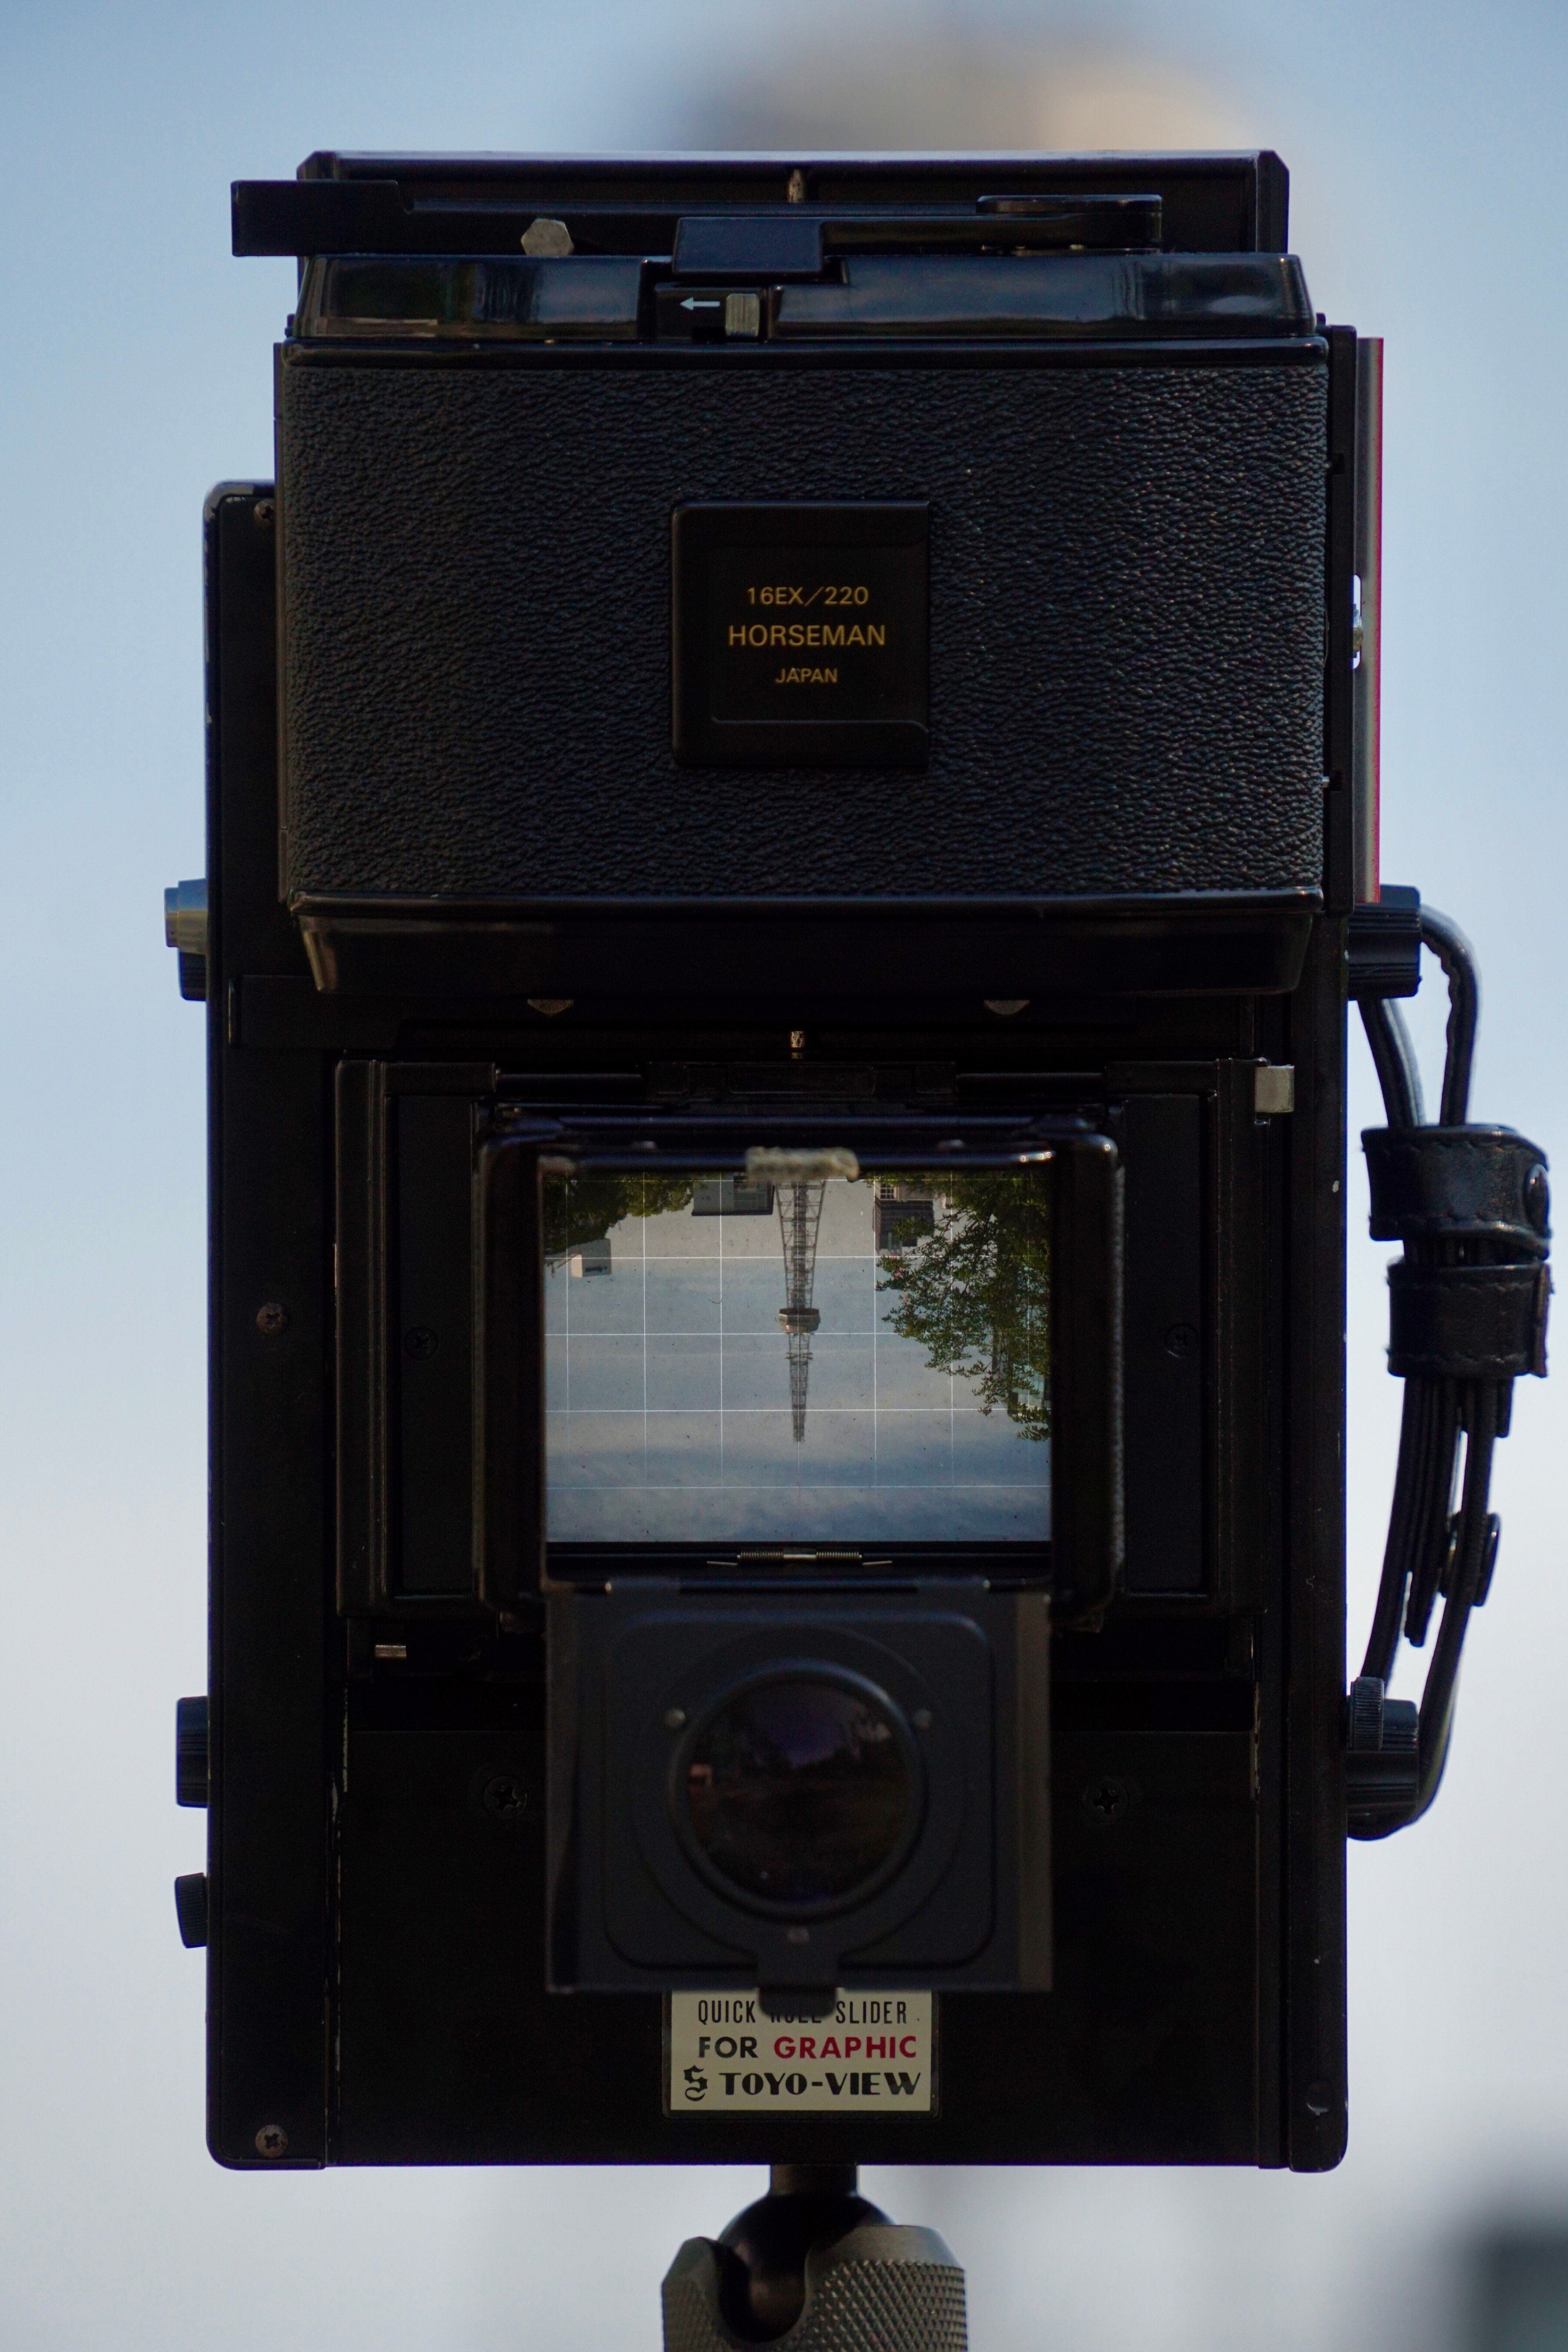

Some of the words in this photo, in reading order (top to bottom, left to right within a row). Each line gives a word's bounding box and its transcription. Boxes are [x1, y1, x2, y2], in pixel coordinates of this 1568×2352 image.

[746, 586, 869, 606] 16EX/220
[729, 624, 885, 647] HORSEMAN
[775, 667, 837, 683] JAPAN
[698, 1999, 756, 2025] QUICK
[834, 2000, 907, 2025] SLIDER
[698, 2036, 759, 2059] FOR
[774, 2036, 916, 2059] GRAPHIC
[718, 2072, 921, 2096] TOYO-VIEW
